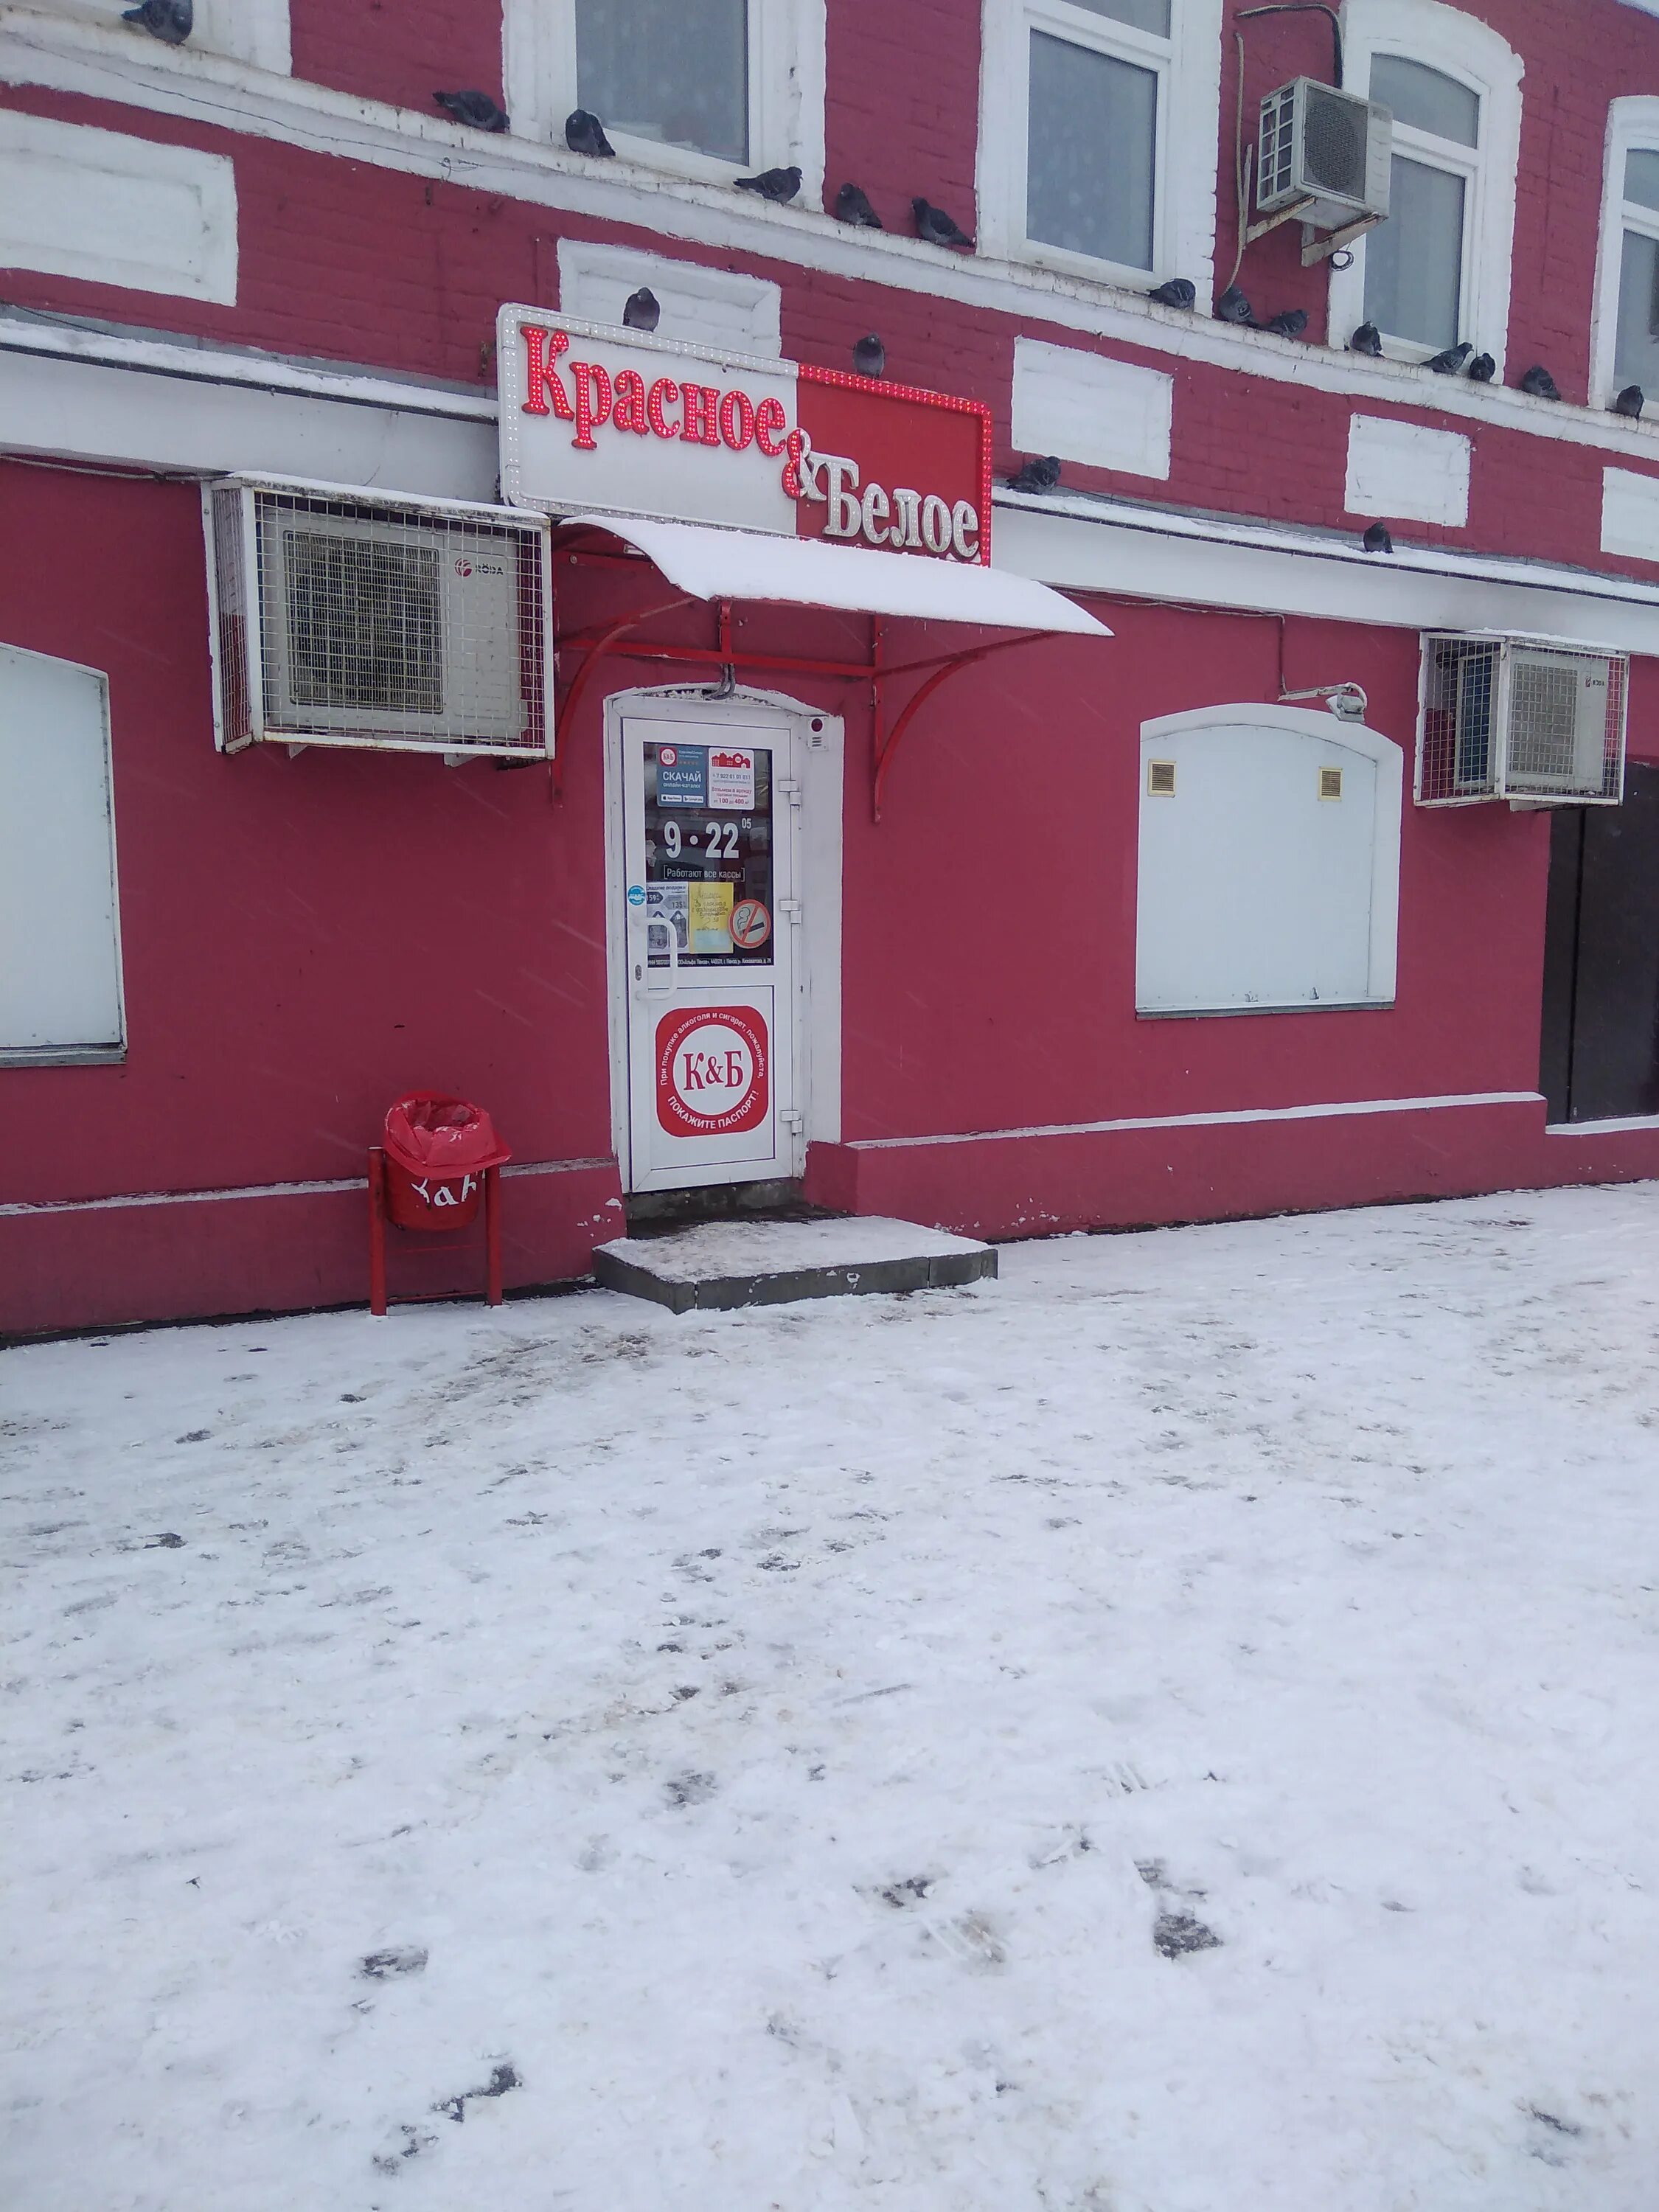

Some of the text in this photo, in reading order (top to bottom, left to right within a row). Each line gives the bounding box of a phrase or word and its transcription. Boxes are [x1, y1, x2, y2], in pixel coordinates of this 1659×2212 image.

[520, 326, 980, 559] Красное & Белое
[663, 771, 701, 782] СКАЧАЙ
[664, 818, 752, 858] 9 22 05
[678, 1012, 711, 1034] алкоголя
[718, 1013, 747, 1032] сигарет,
[661, 1032, 679, 1067] покупке
[746, 1029, 765, 1079] пожалуйста,
[660, 1068, 669, 1086] При
[682, 1050, 744, 1091] К&Б
[667, 1089, 759, 1130] ПОКАЖИТЕ ПАСПОРТ!
